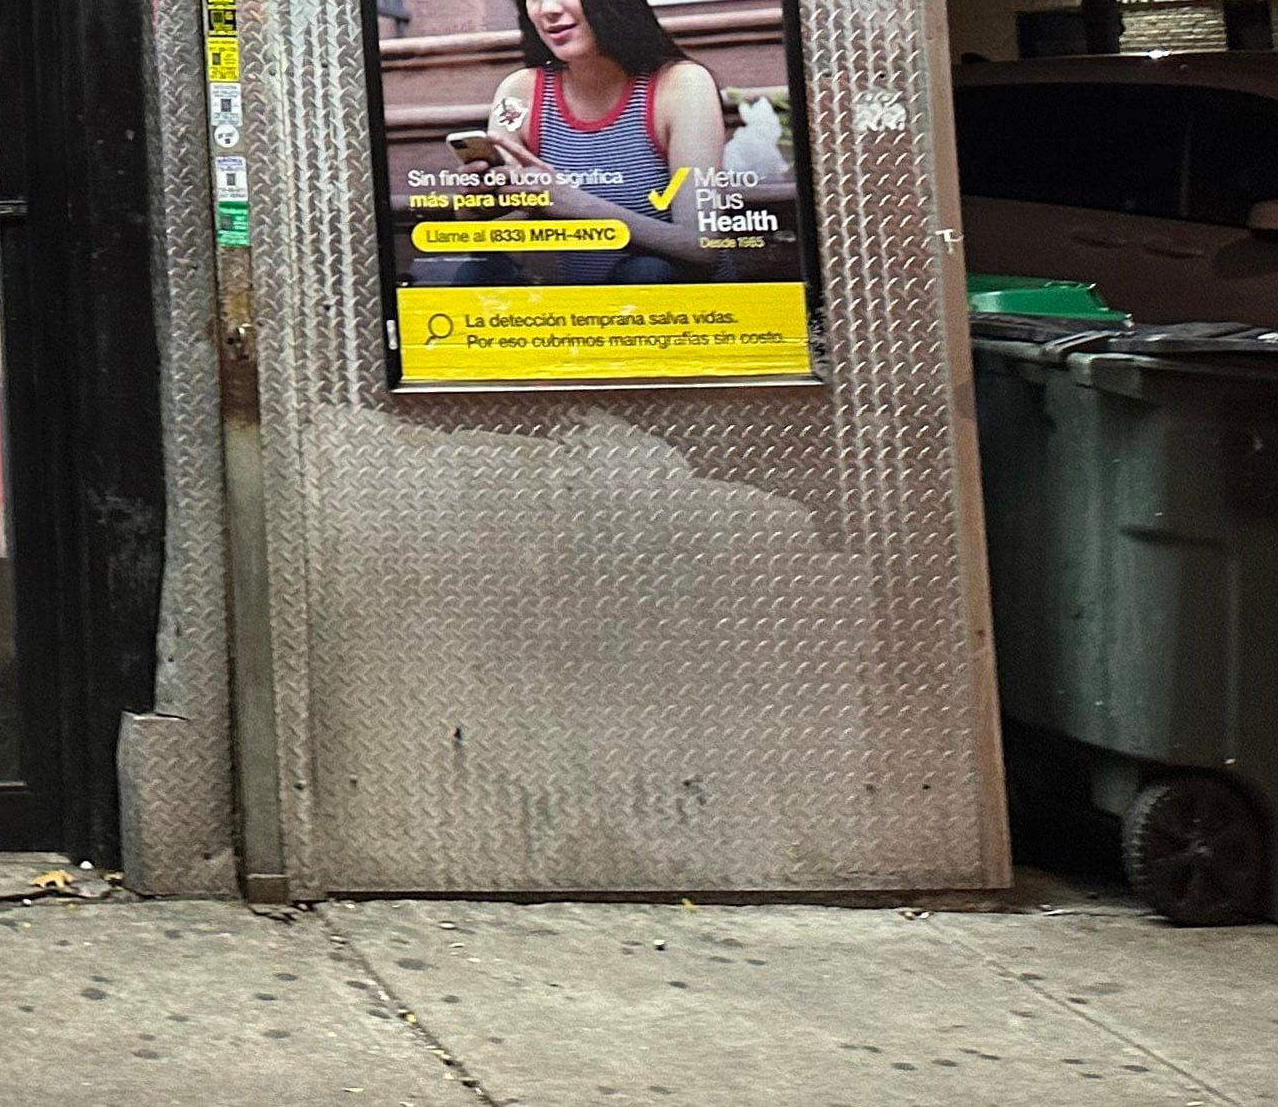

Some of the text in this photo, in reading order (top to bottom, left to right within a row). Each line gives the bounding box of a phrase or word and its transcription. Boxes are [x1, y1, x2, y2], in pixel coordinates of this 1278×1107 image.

[407, 169, 624, 189] Sin fines de lucro significa
[409, 191, 554, 210] más para usted.
[695, 189, 744, 210] Plus
[697, 210, 778, 232] Health
[426, 227, 617, 244] Llame al (833) MPH-4NYC
[700, 237, 736, 248] Desde
[465, 311, 738, 329] La detección temprana salva vidas.
[467, 334, 493, 348] Por
[499, 336, 527, 348] eso
[532, 334, 604, 348] cubrimos
[714, 331, 734, 345] sin
